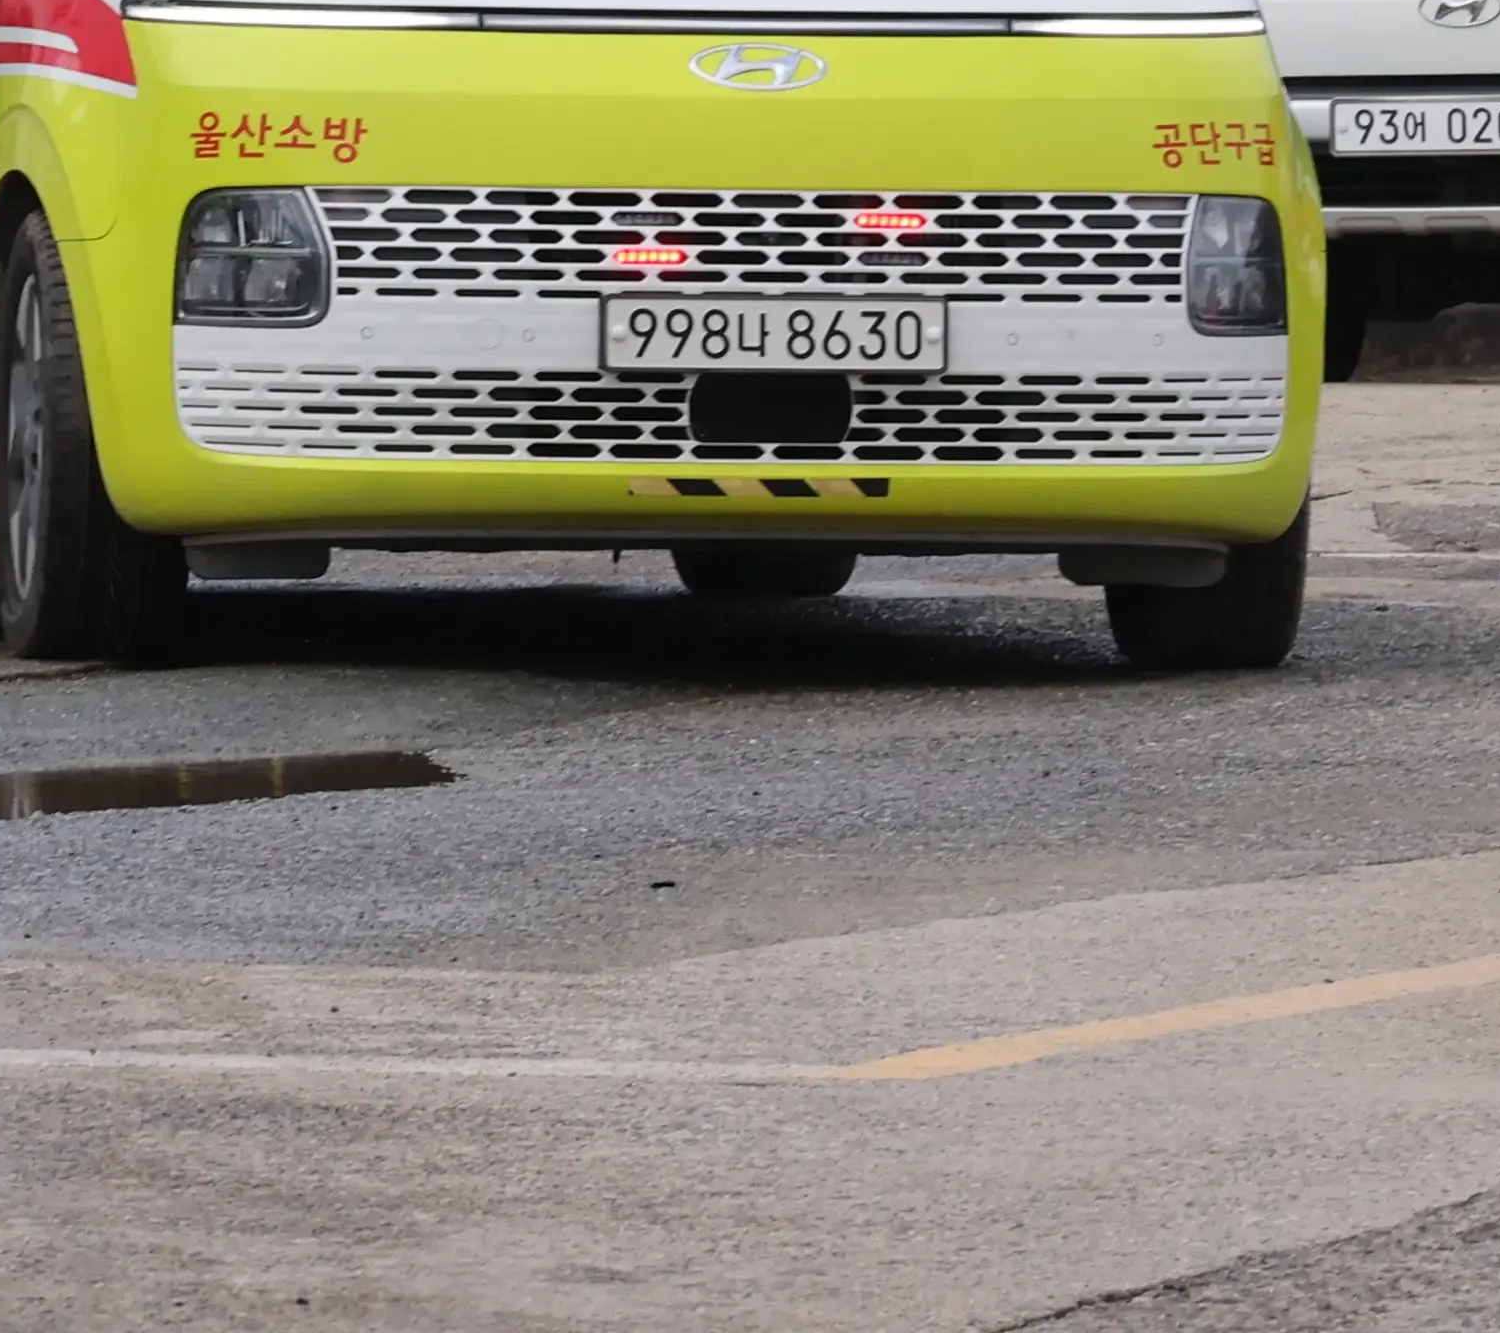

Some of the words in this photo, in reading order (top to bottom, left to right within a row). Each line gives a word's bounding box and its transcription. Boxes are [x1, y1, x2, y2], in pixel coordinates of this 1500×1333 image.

[189, 111, 368, 164] 울산소방
[1152, 121, 1276, 169] 공단구급
[1354, 108, 1426, 145] 93어
[628, 307, 770, 361] 998나
[786, 308, 923, 362] 8630
